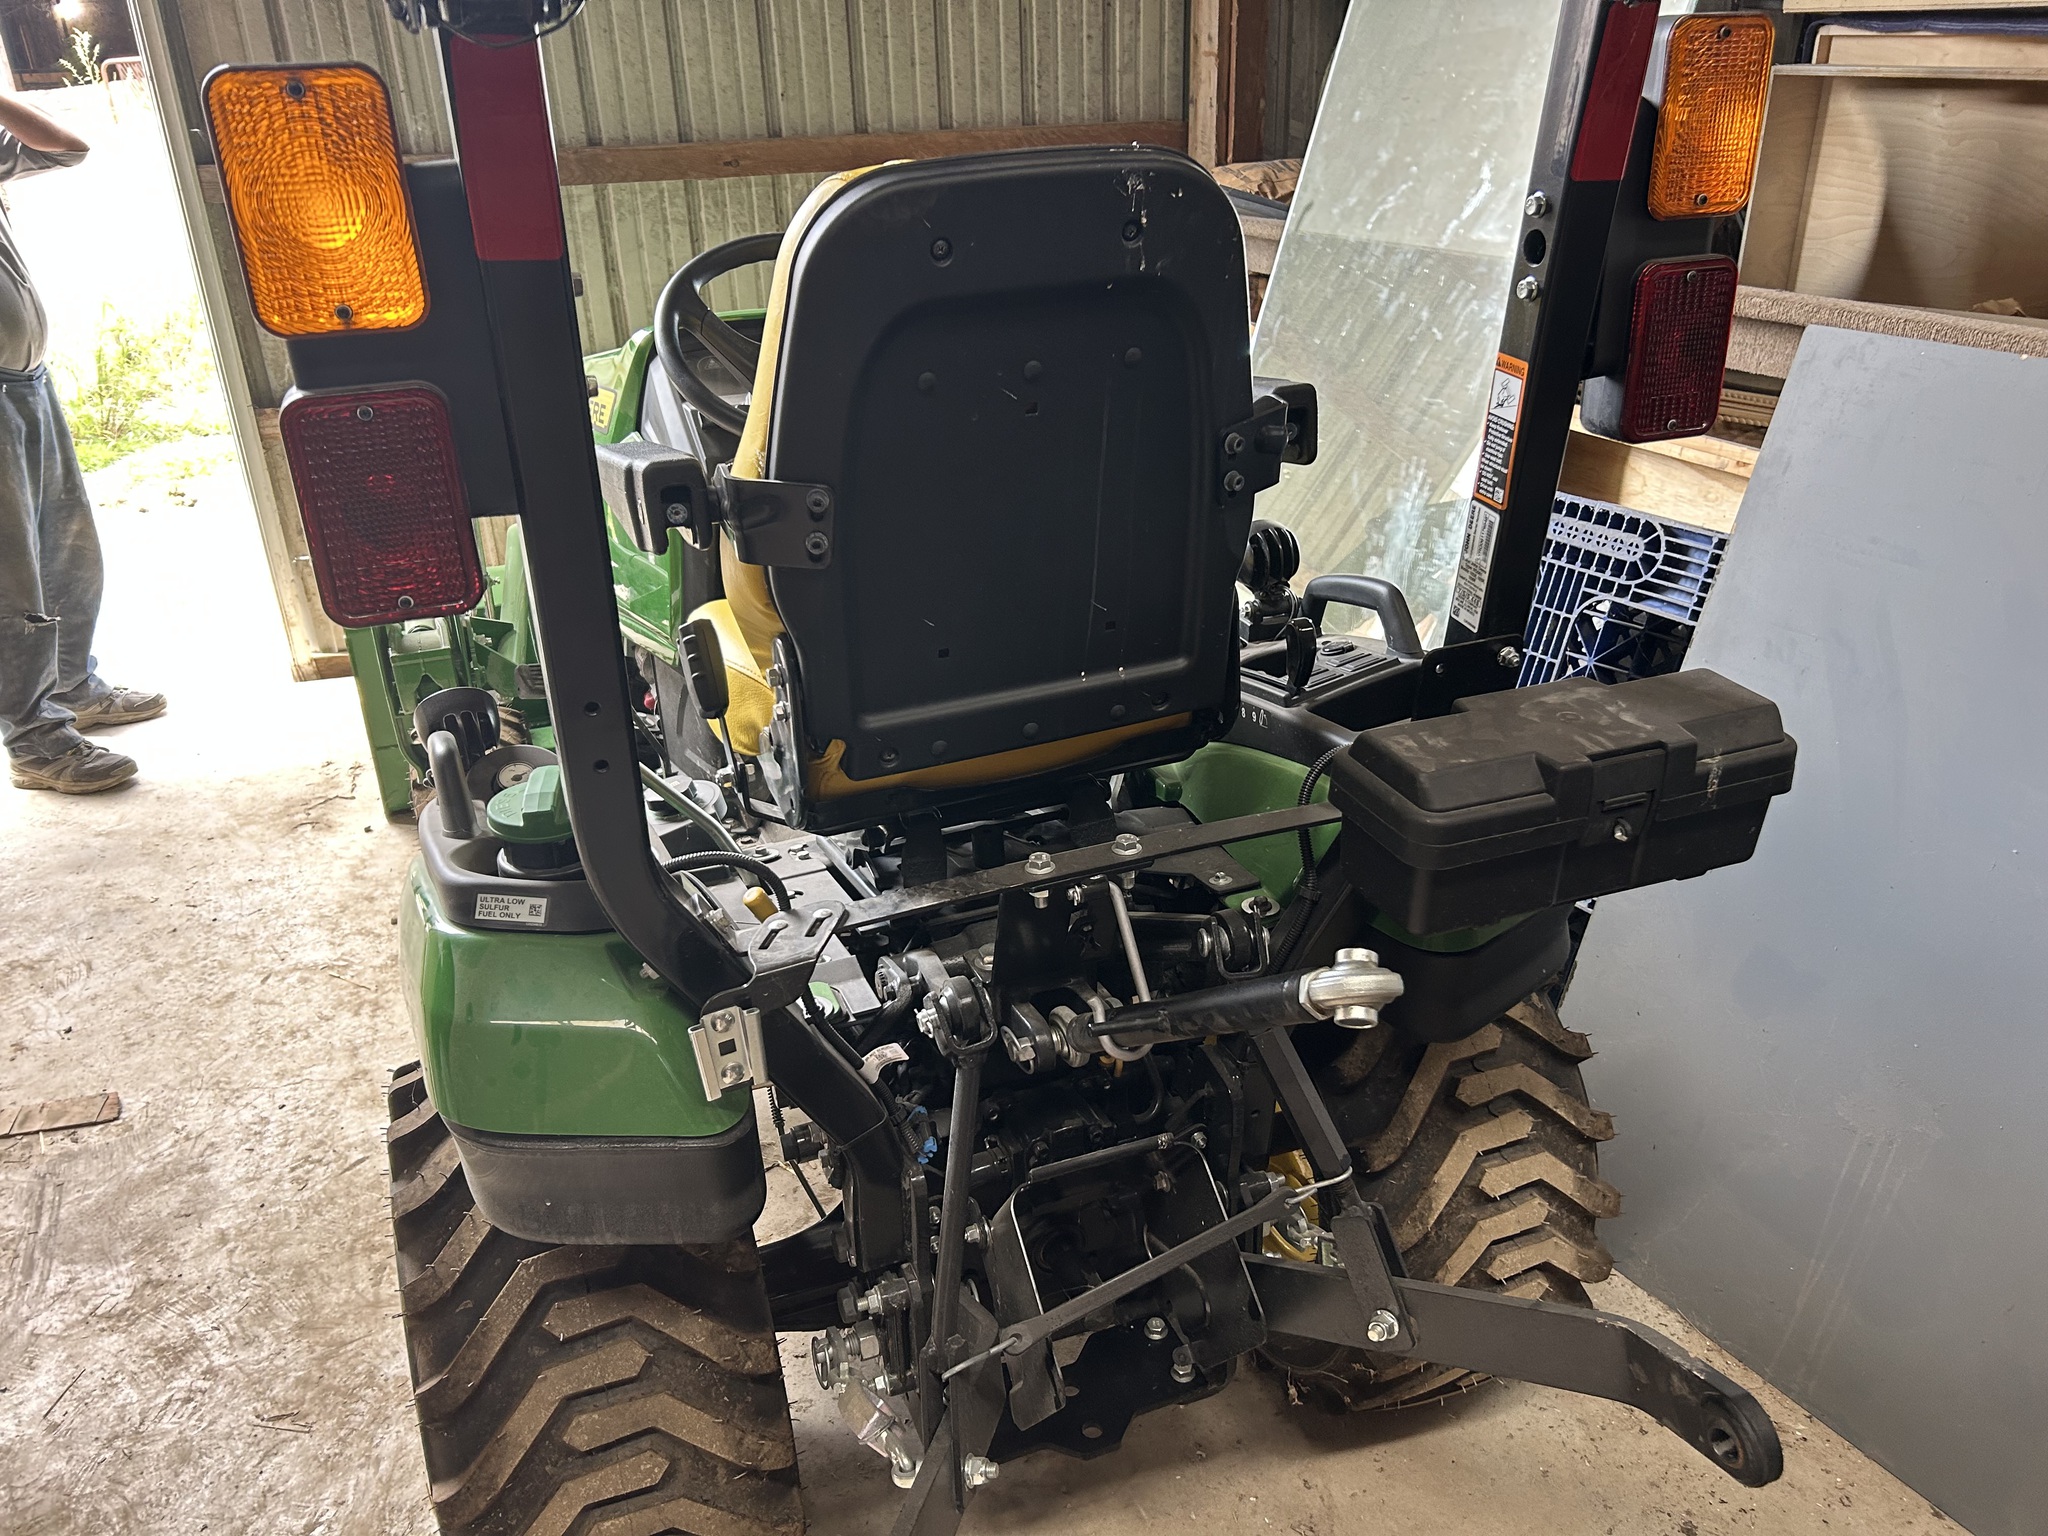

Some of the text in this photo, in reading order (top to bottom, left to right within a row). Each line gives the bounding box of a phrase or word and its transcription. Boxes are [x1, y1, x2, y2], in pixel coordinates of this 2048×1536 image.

[1502, 360, 1525, 376] WARNING
[1463, 532, 1471, 554] JOHN
[1467, 504, 1476, 530] DEERE
[1241, 707, 1257, 722] 8 9
[480, 896, 505, 904] ULTRA
[479, 903, 510, 911] SULFUR
[478, 910, 521, 919] FUEL ONLY
